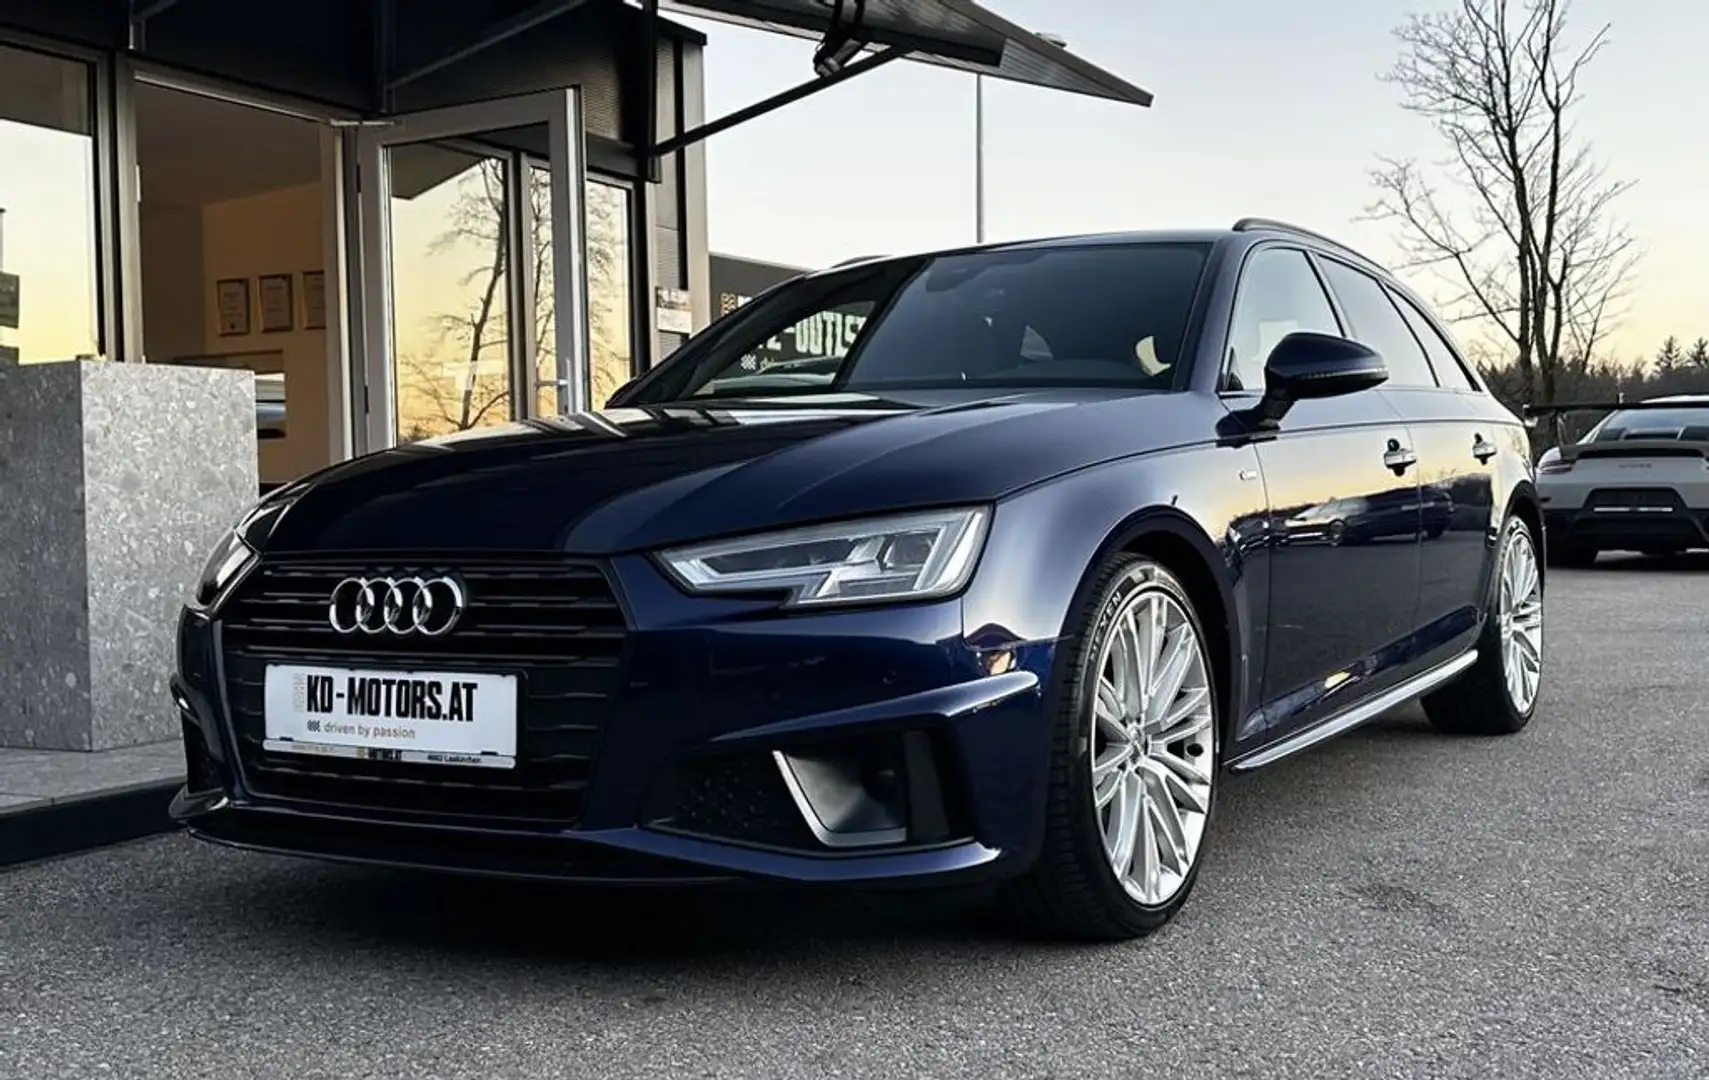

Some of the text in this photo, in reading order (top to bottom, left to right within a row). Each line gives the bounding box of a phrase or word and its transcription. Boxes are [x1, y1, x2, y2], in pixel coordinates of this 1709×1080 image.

[307, 674, 478, 721] KD-MOTORS.AT
[324, 721, 415, 740] driven by passion
